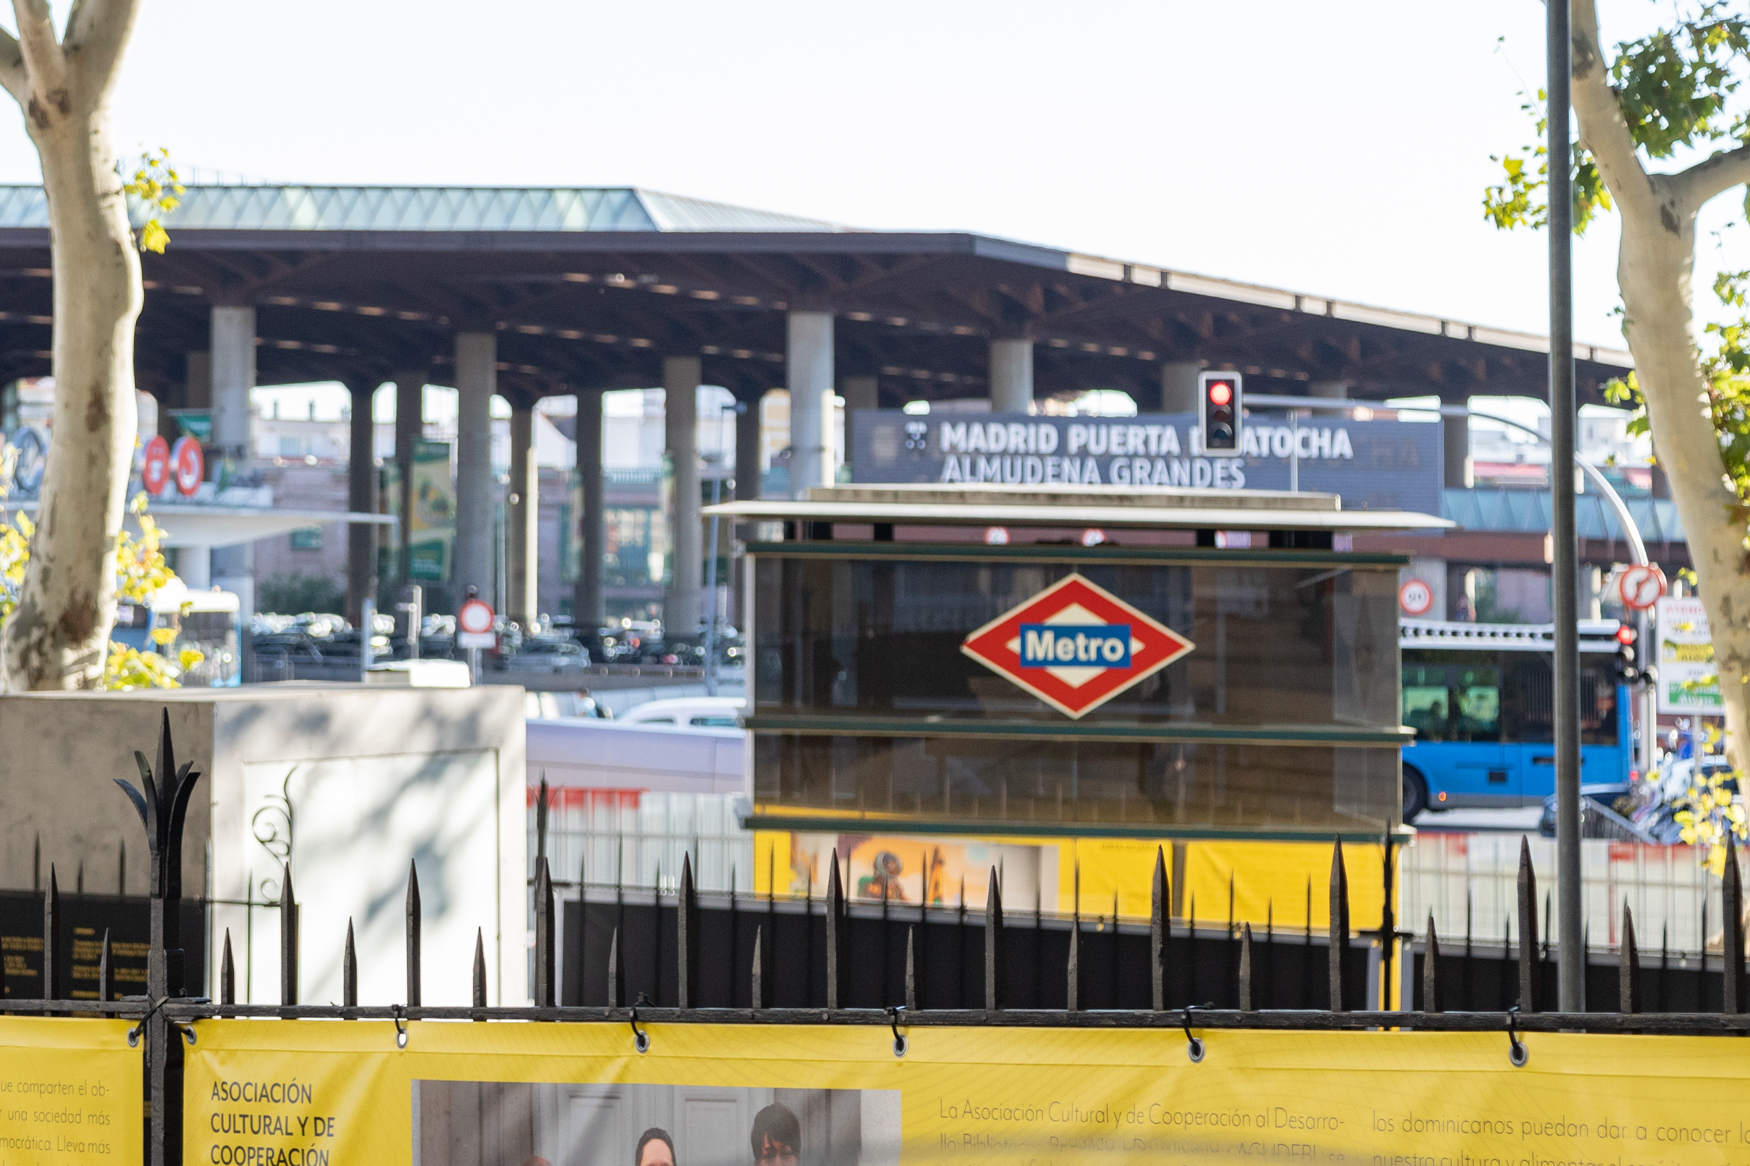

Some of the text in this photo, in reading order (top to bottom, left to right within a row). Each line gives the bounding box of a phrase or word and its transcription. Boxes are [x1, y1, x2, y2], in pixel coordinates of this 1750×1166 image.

[940, 423, 1059, 454] MADRID
[1067, 425, 1178, 456] PUERTA
[1241, 428, 1353, 459] ATOCHA
[942, 457, 1246, 488] ALMUDENA GRANDES
[1025, 629, 1125, 662] Metro
[17, 1080, 74, 1098] comparten
[78, 1078, 86, 1095] el
[91, 1080, 109, 1097] ob-
[211, 1078, 312, 1104] ASOCIACIÓN
[8, 1109, 27, 1122] una
[33, 1105, 81, 1123] sociedad
[88, 1110, 110, 1125] más
[211, 1113, 335, 1137] CULTURAL Y DE
[940, 1099, 1345, 1130] La Asociación Cultural y de Cooperación al Desarro-
[1373, 1111, 1731, 1144] los dominicanos puedan dar a conocer
[57, 1135, 84, 1153] Lleva
[88, 1139, 110, 1154] más
